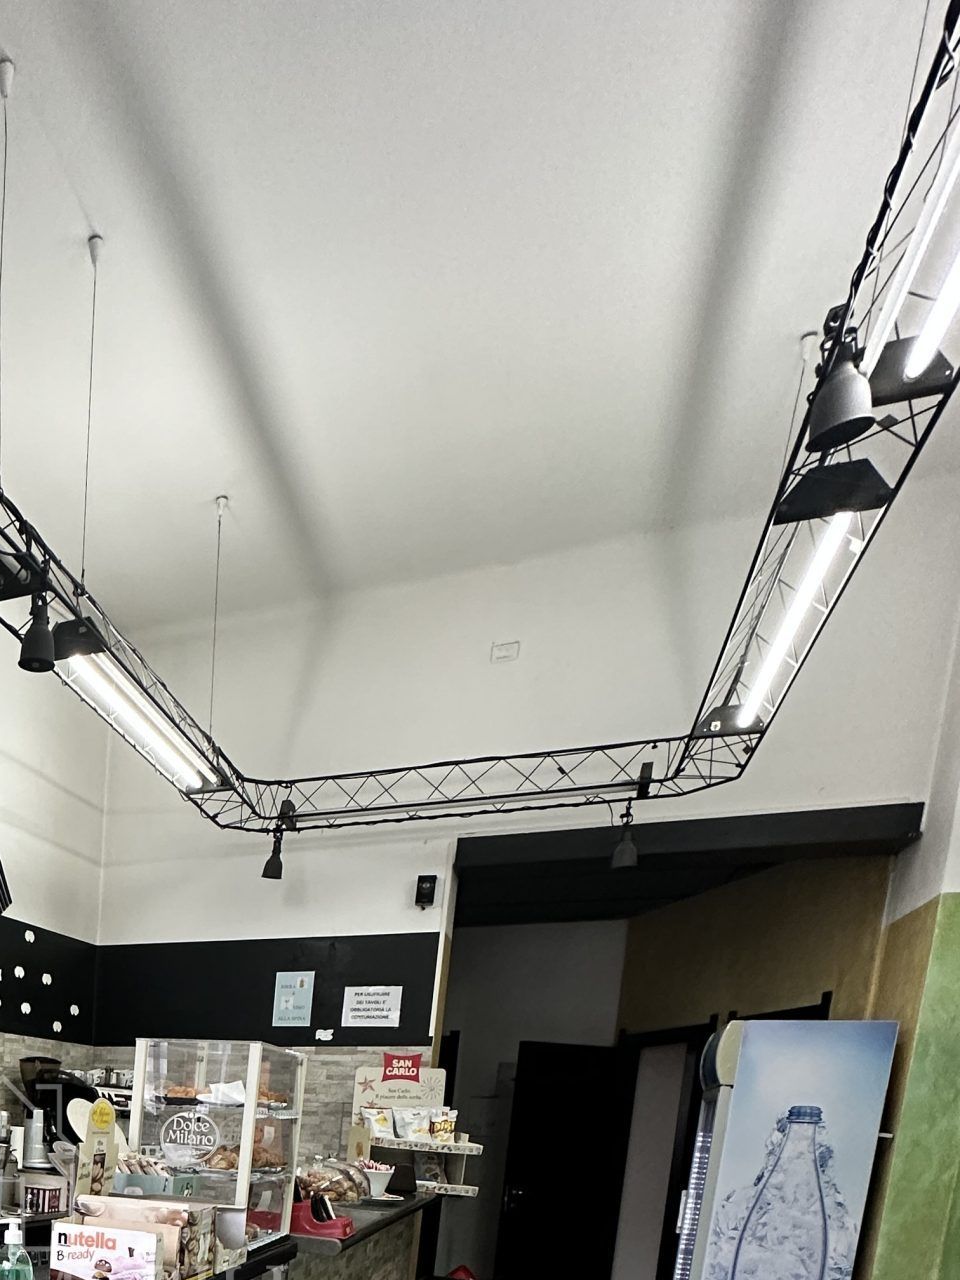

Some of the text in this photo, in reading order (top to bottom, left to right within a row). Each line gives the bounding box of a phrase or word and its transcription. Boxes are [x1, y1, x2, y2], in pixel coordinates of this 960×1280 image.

[392, 1059, 413, 1068] SAN
[385, 1067, 418, 1076] CARLO
[173, 1117, 210, 1132] Dolce
[166, 1129, 214, 1146] Milano
[58, 1231, 117, 1250] nutella
